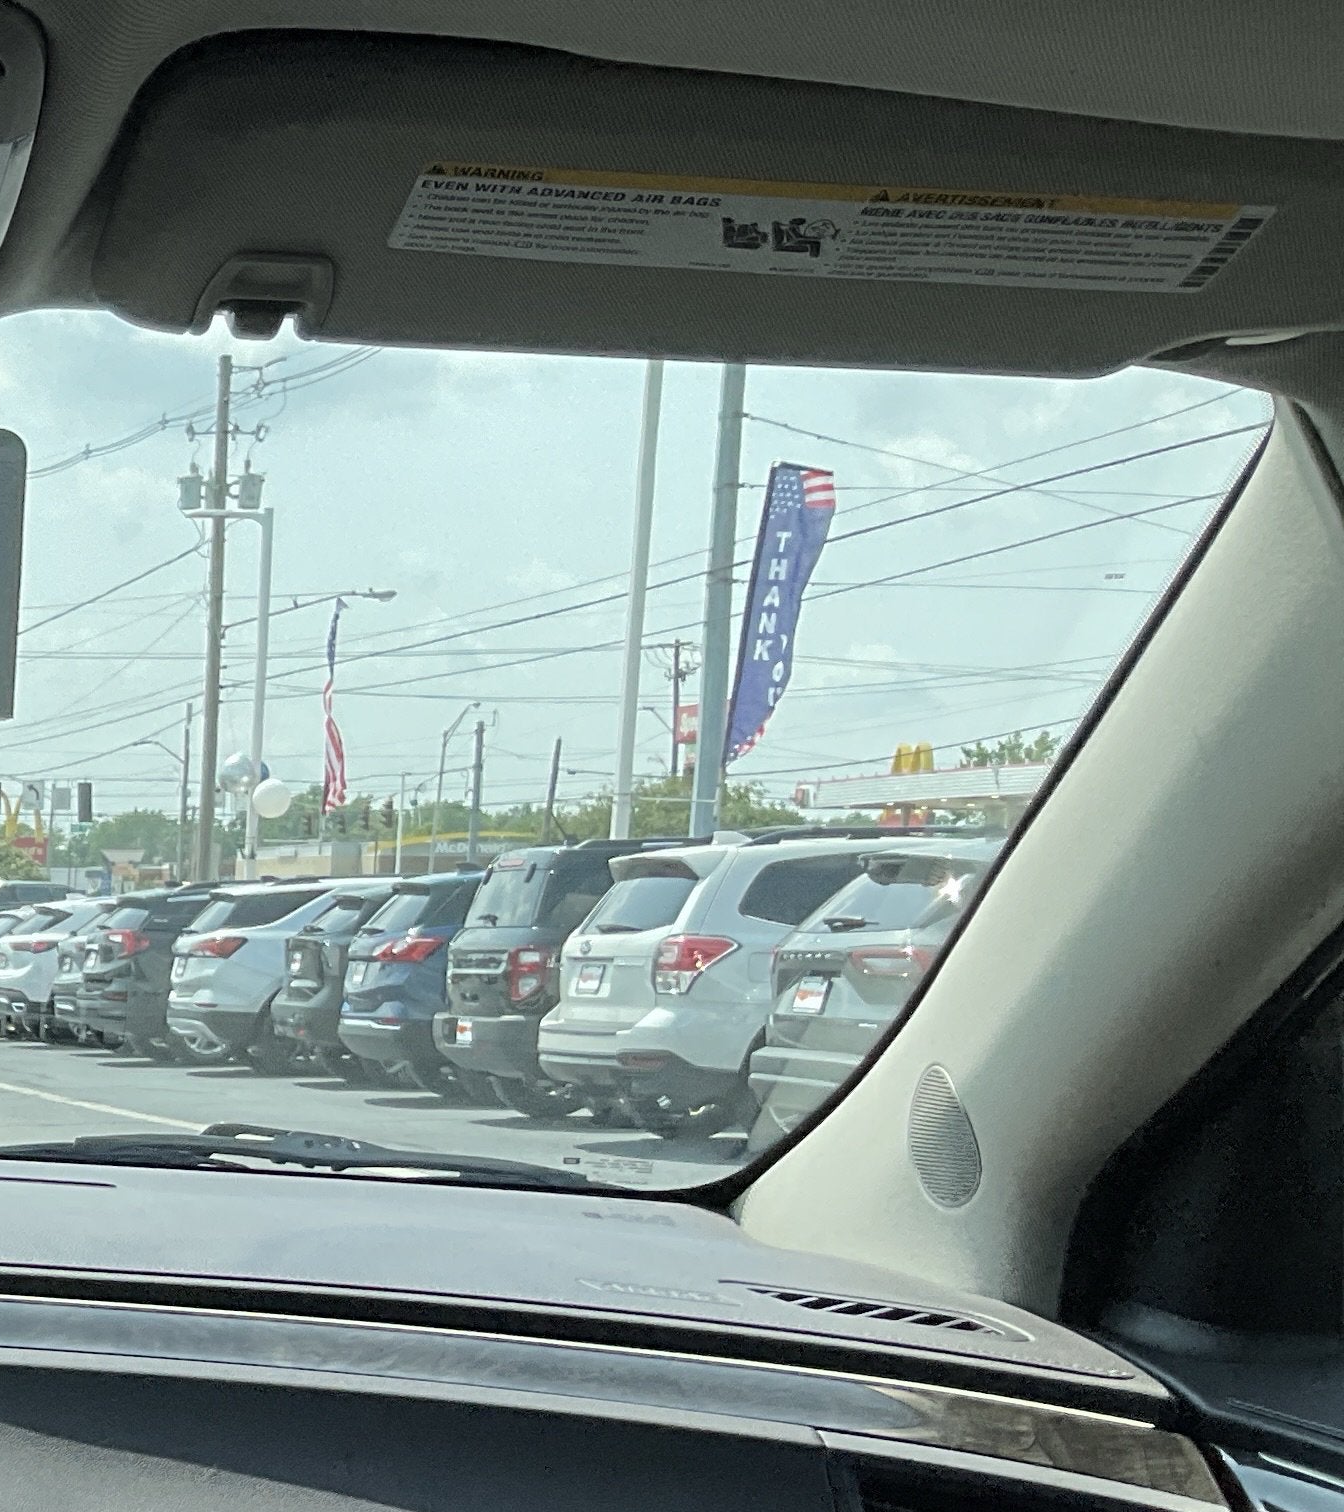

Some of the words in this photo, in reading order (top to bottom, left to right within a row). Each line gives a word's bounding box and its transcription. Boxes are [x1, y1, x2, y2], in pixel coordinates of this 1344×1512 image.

[453, 166, 544, 182] WARNING
[421, 179, 469, 191] EVEN
[474, 182, 523, 195] WITH
[527, 186, 626, 203] ADVANCED
[631, 193, 665, 204] AIR
[670, 195, 722, 208] BAGS
[752, 530, 793, 661] THANK
